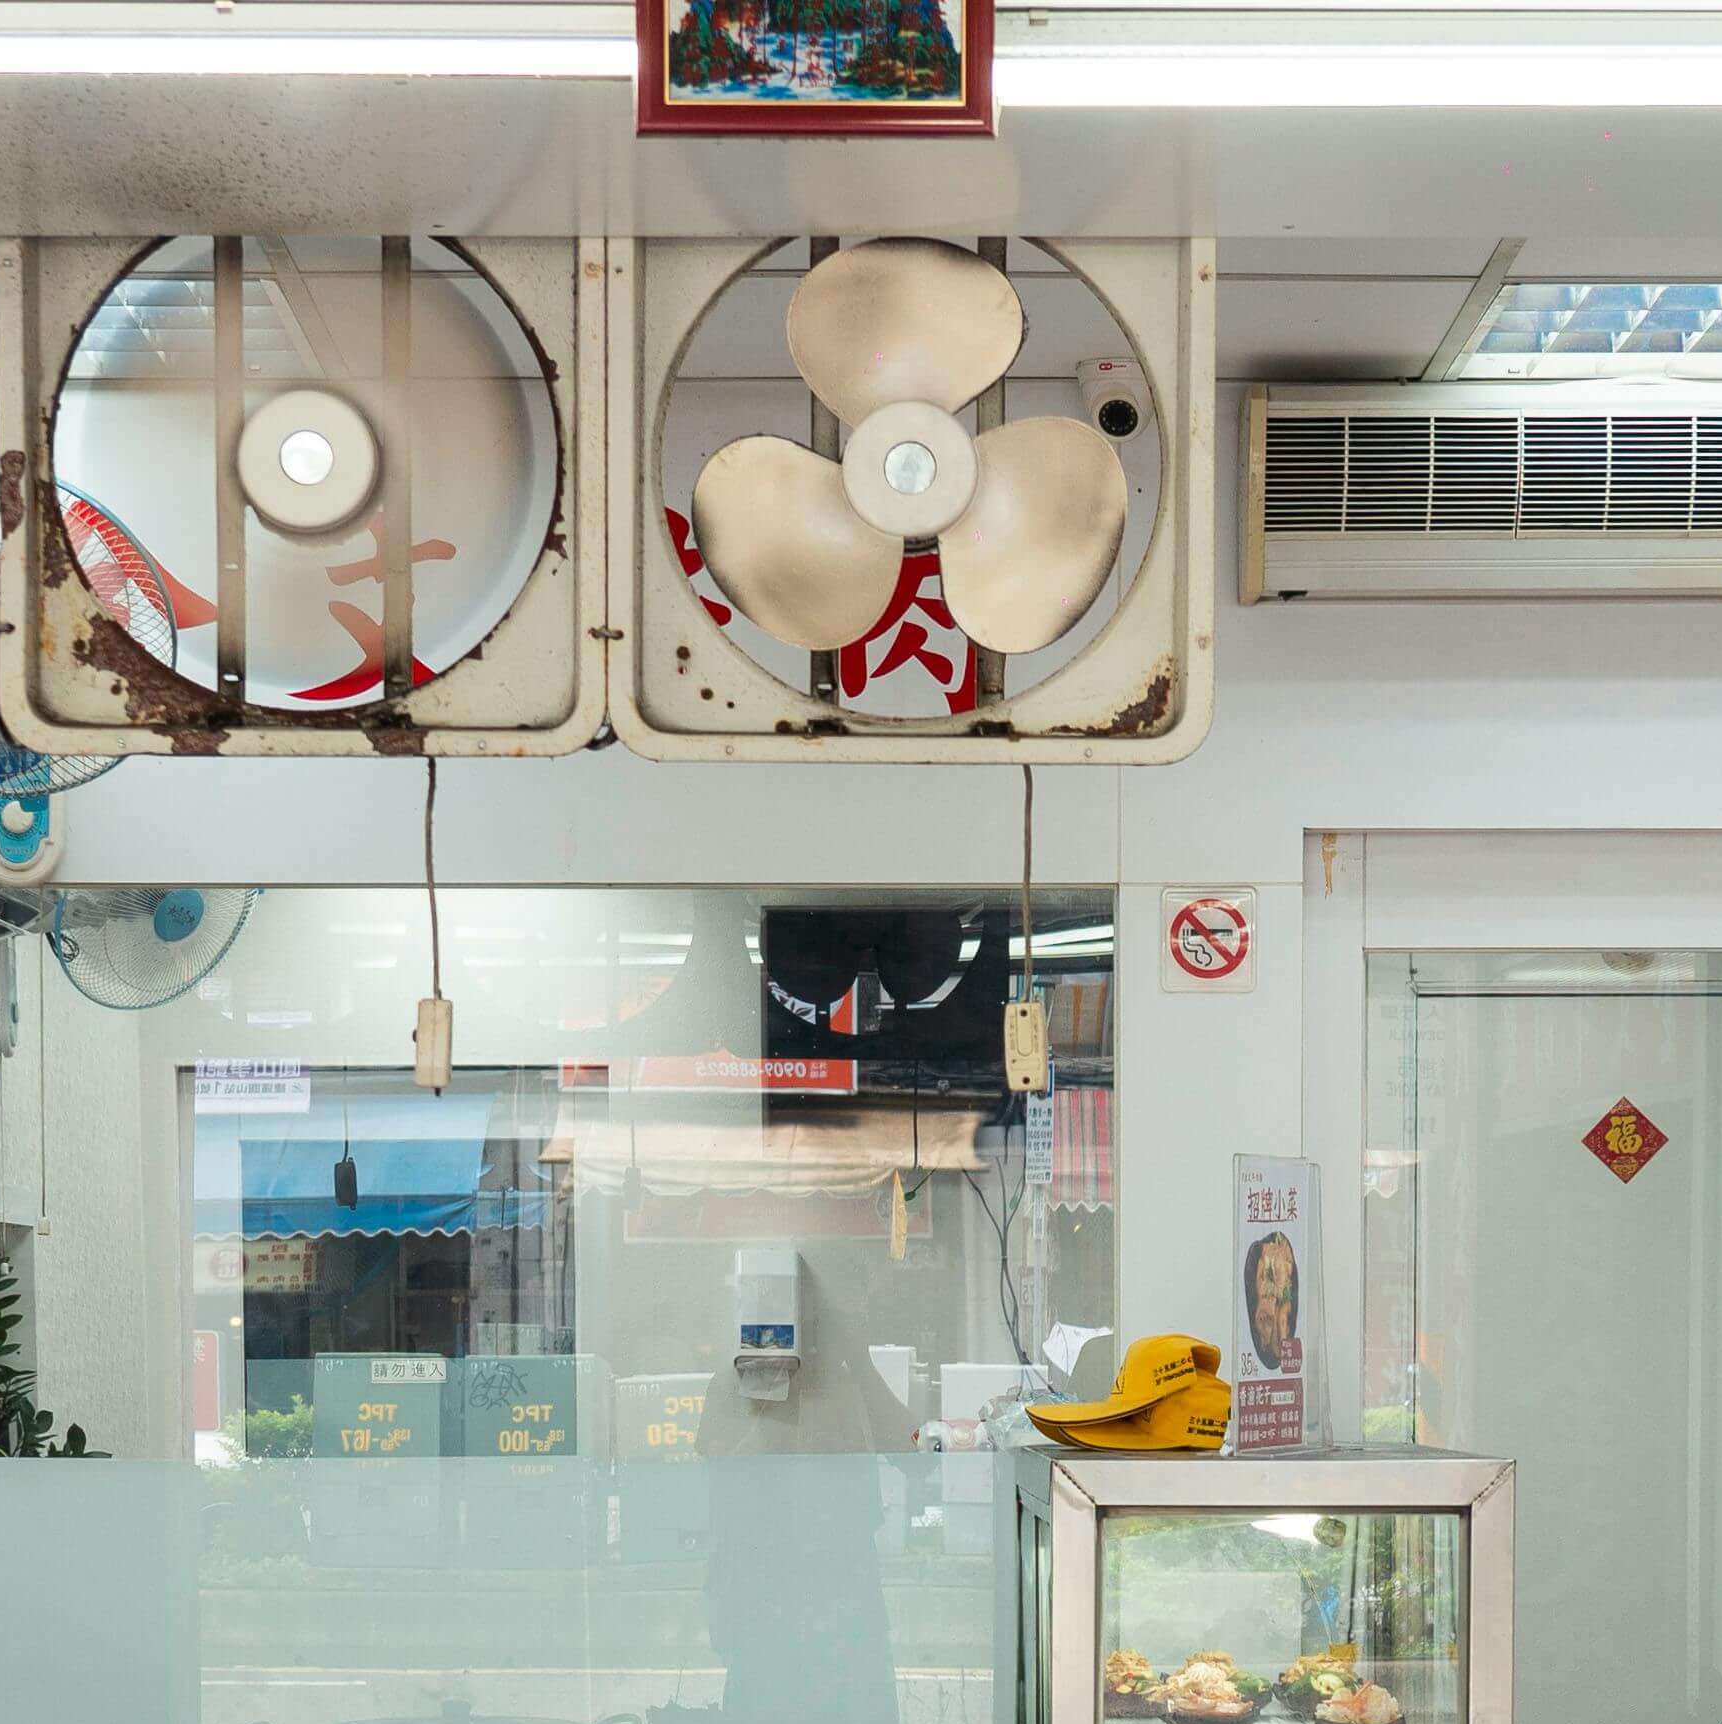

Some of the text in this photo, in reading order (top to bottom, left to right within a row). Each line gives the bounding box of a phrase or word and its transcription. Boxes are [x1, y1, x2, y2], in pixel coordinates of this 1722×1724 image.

[1605, 1115, 1643, 1155] 福
[374, 1362, 445, 1379] 請勿進入
